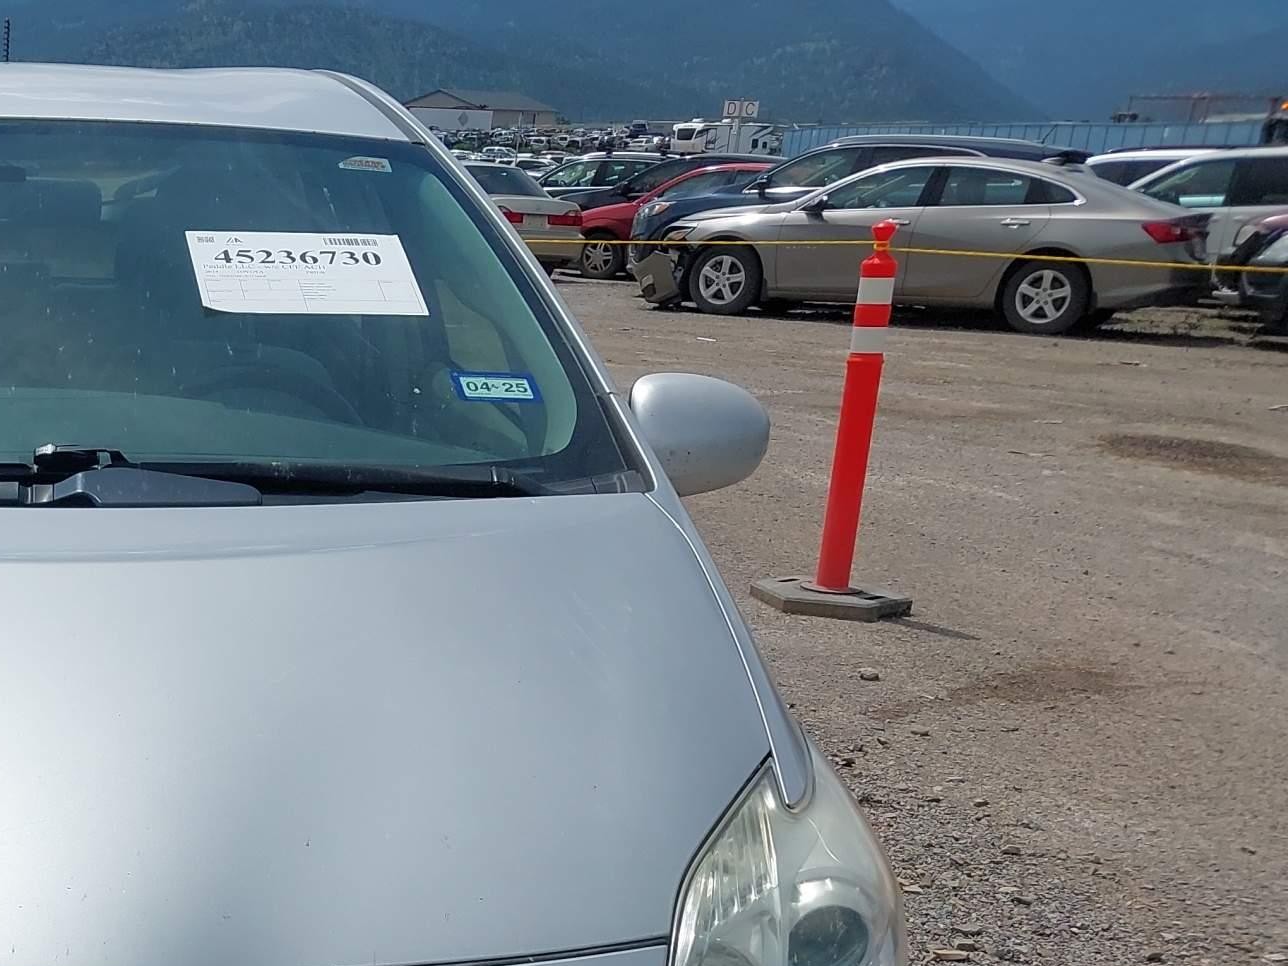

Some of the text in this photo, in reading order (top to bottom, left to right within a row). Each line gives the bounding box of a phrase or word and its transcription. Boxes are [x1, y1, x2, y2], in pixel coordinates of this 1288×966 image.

[727, 102, 755, 115] D C
[213, 249, 382, 266] 45236730
[465, 381, 527, 393] 04 25
